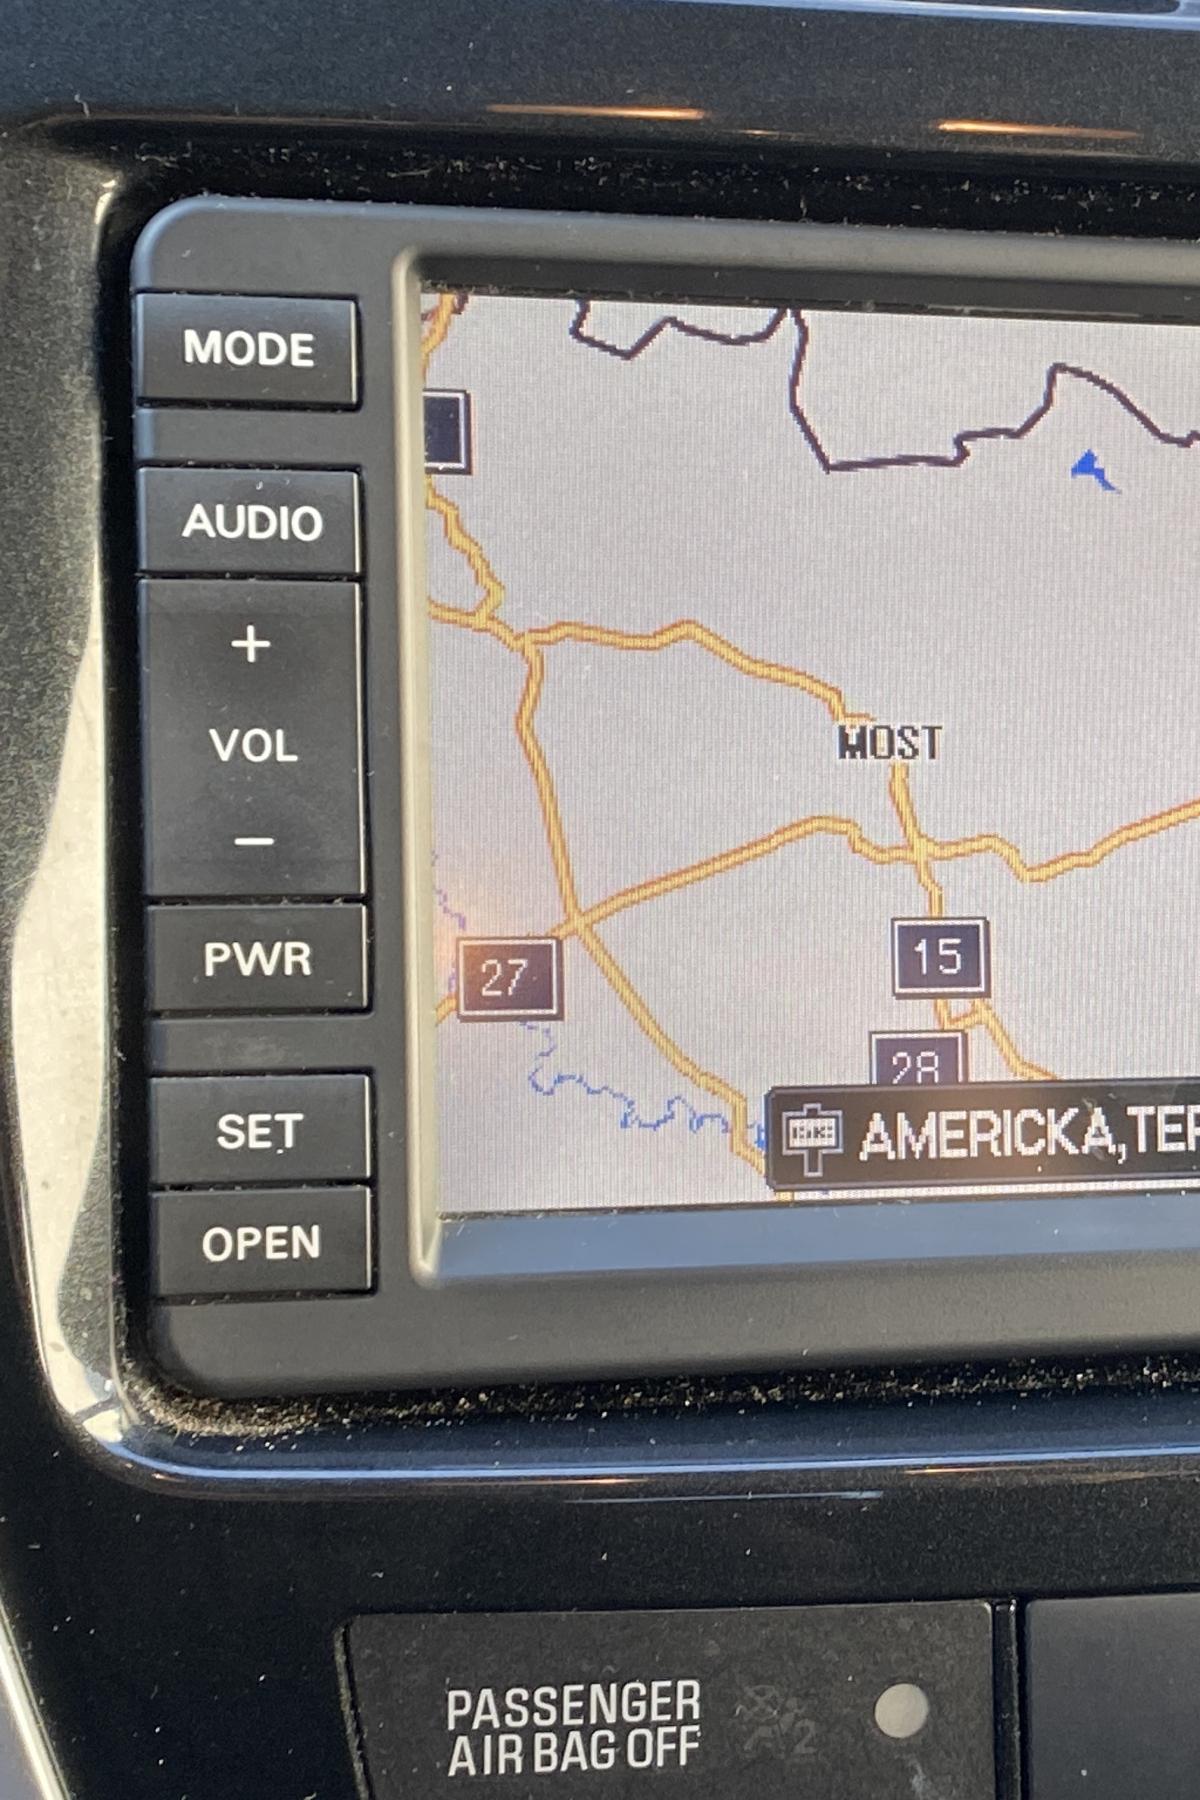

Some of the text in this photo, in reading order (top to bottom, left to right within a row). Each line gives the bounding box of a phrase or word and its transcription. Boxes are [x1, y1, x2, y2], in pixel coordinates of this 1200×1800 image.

[183, 329, 314, 367] MODE
[182, 503, 323, 541] AUDIO
[209, 729, 298, 763] VOL
[838, 725, 942, 760] MOST
[204, 942, 312, 977] PWR
[914, 938, 962, 976] 15
[481, 959, 528, 997] 27
[217, 1113, 303, 1149] SET
[202, 1226, 320, 1262] OPEN
[447, 1679, 700, 1730] PASSENGER
[448, 1725, 700, 1777] AIR BAG OFF
